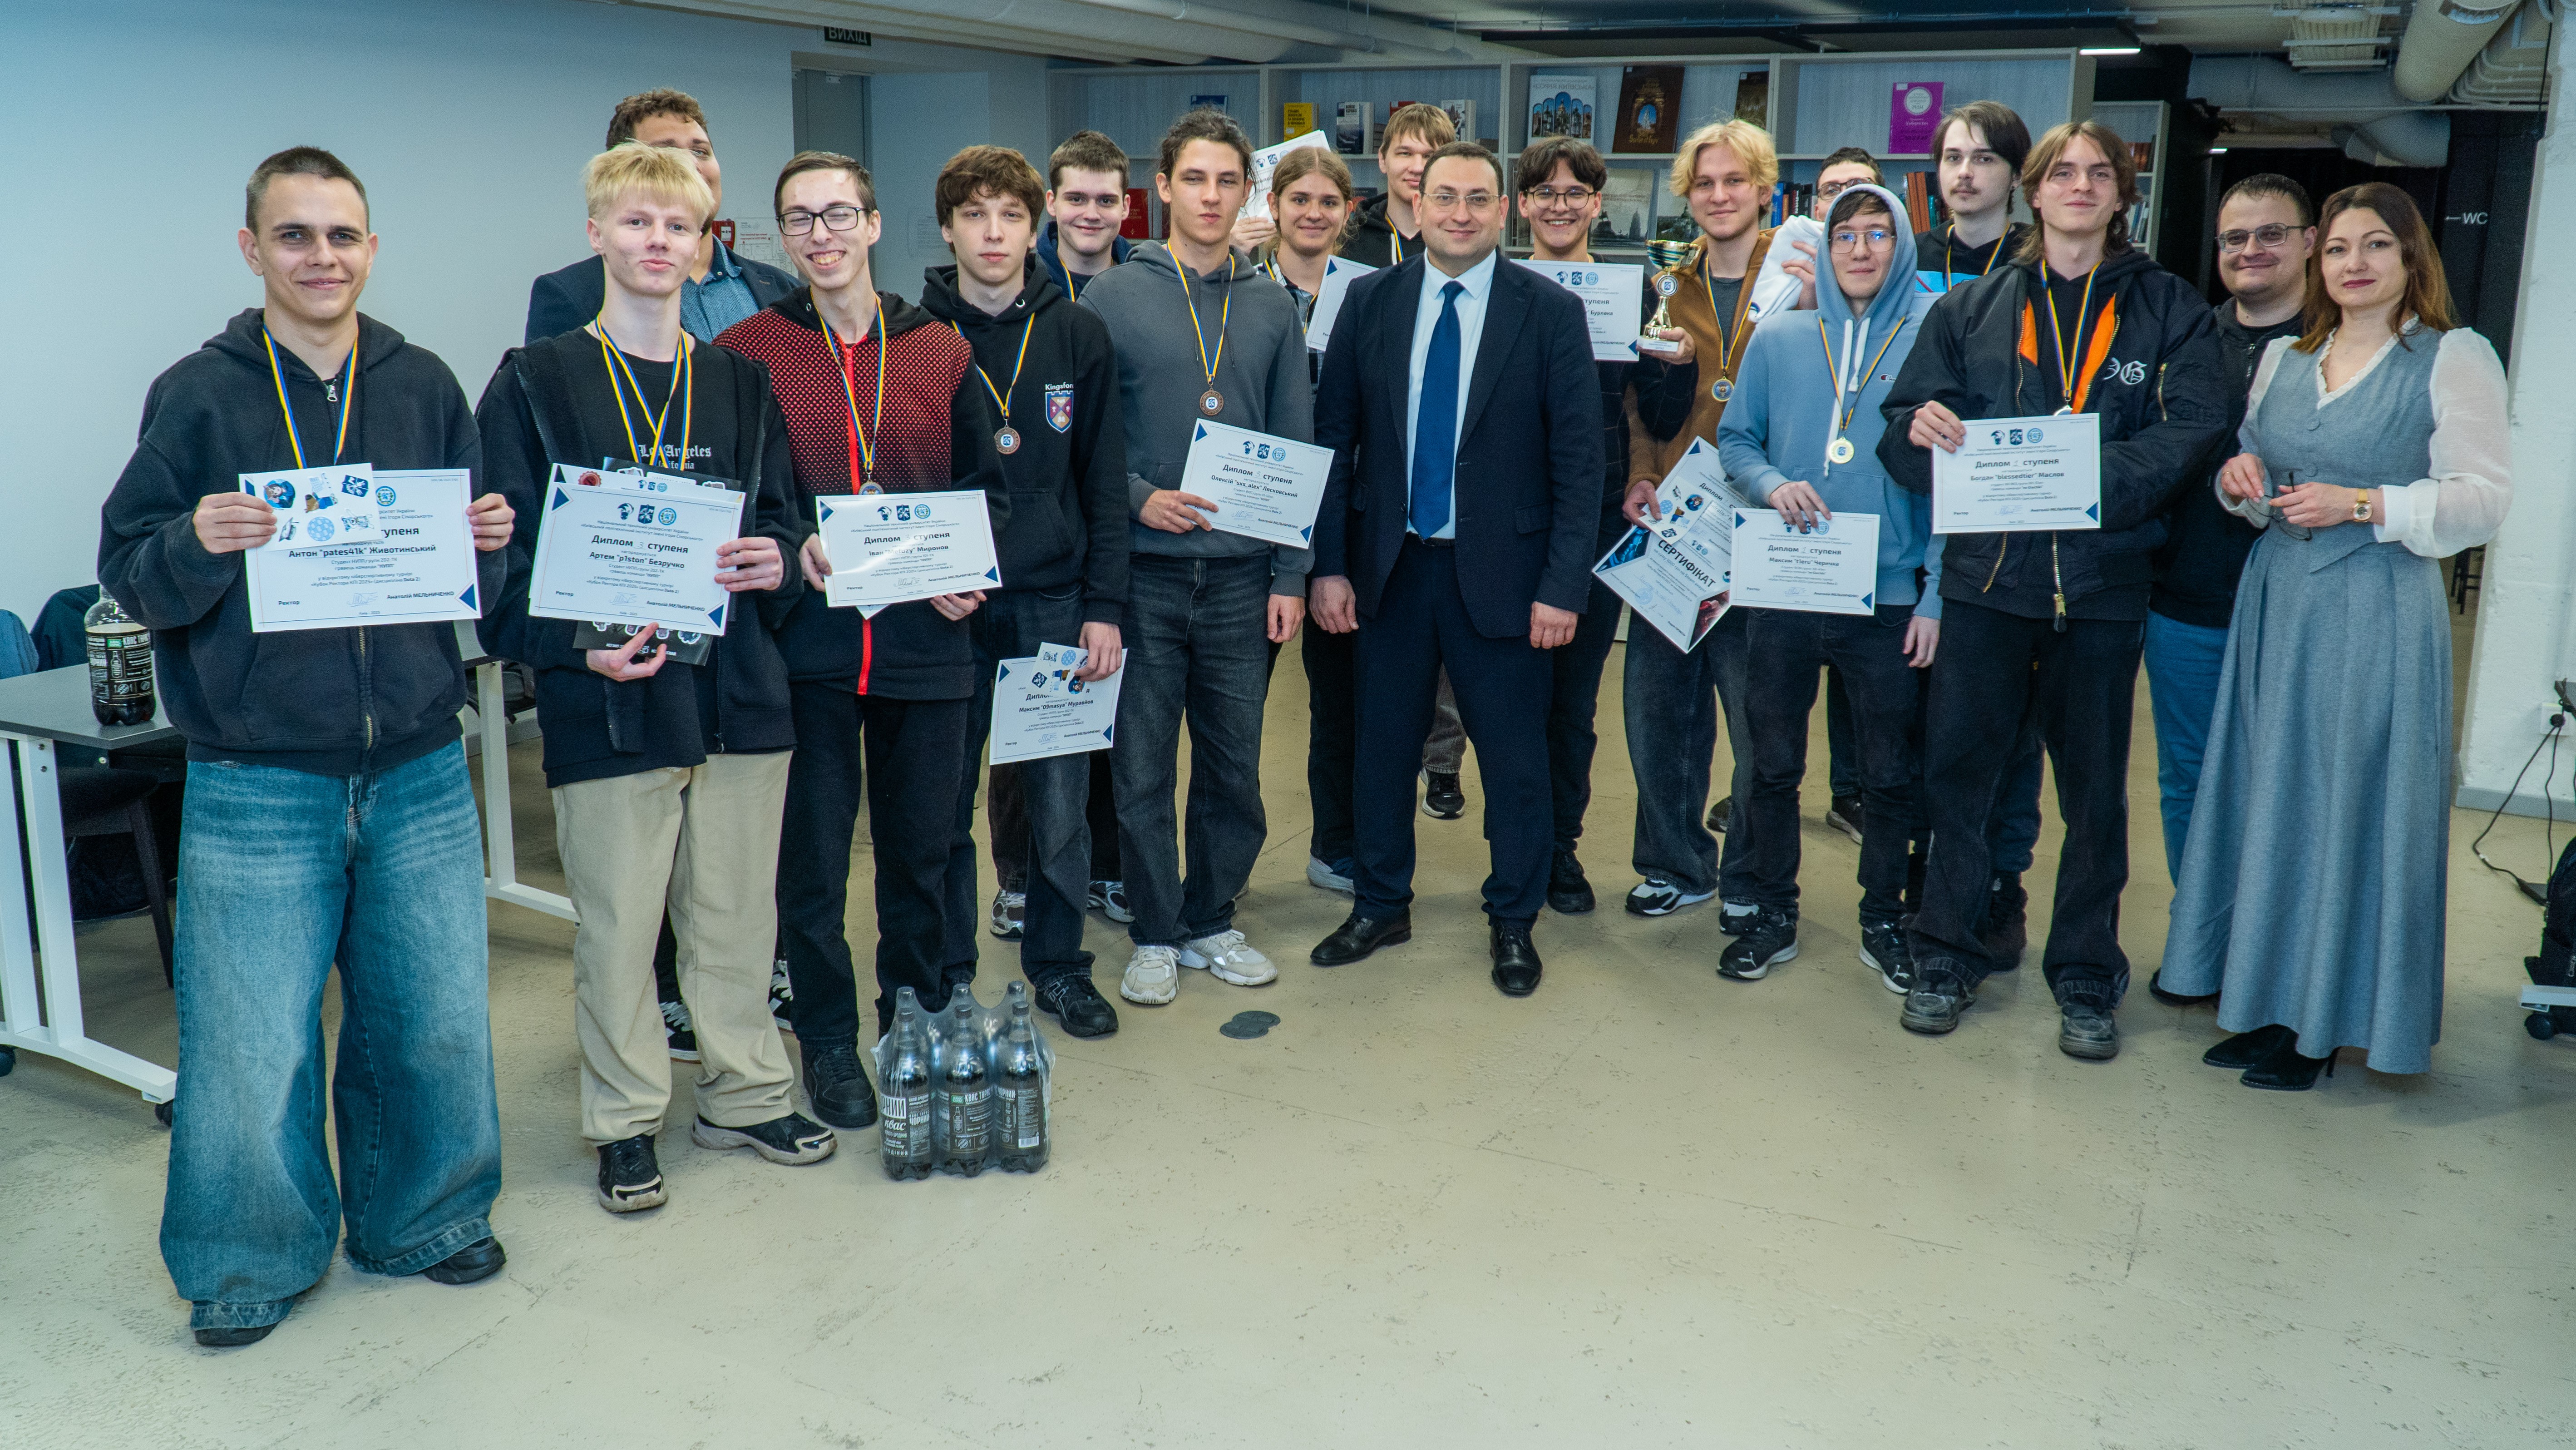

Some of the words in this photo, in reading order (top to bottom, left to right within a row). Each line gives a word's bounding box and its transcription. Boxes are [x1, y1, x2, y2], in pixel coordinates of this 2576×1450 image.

[829, 27, 867, 44] ВИХІД
[2462, 212, 2488, 224] WC
[1045, 382, 1074, 391] Kingsfor
[1975, 460, 2010, 469] Диплом
[2023, 458, 2059, 467] ступеня
[1222, 464, 1253, 477] Диплом
[1262, 473, 1293, 486] ступеня
[1210, 474, 1234, 484] Олексій
[1234, 479, 1262, 491] "sxs_alex"
[1262, 485, 1298, 498] Лясковський
[1699, 481, 1724, 502] Диплом
[381, 527, 419, 538] упеня
[864, 535, 901, 544] Диплом
[913, 532, 950, 541] ступеня
[592, 534, 633, 548] Диплом
[646, 543, 688, 555] ступеня
[1768, 544, 1799, 553] Диплом
[320, 547, 367, 558] "pates41k"
[369, 544, 436, 554] Животинський
[589, 552, 615, 561] Артем
[616, 554, 647, 565] "p1ston"
[648, 559, 685, 569] Безручко
[1657, 537, 1717, 589] СЕРТИФІКАТ
[1684, 573, 1696, 584] Steam
[1026, 691, 1053, 701] Дипл
[1041, 702, 1067, 710] "09masya"
[1067, 698, 1094, 707] Муравйов
[965, 1093, 978, 1103] КВАС
[885, 1119, 906, 1131] квас
